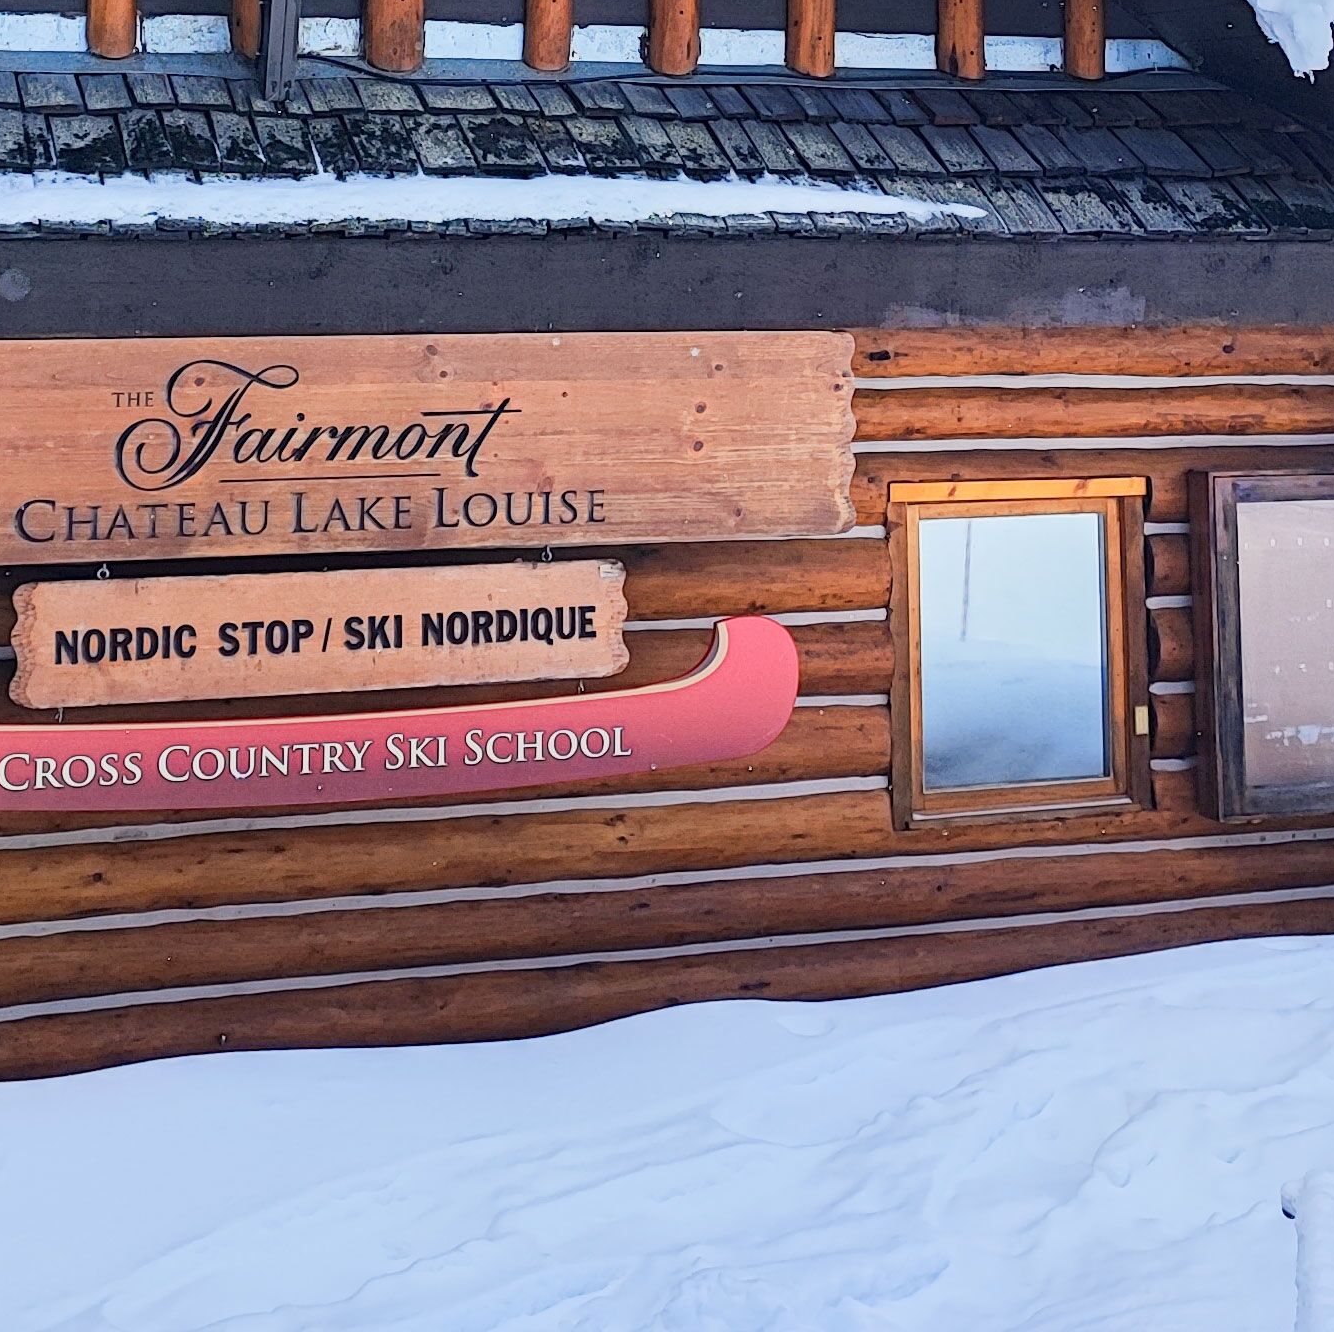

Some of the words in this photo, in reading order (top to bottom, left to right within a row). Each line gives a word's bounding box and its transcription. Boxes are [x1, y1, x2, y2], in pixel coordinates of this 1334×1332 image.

[112, 391, 155, 409] THE
[115, 359, 523, 492] Fairmont
[14, 499, 271, 544] CHATEAU
[291, 491, 413, 534] LAKE
[432, 486, 607, 528] LOUISE
[54, 624, 197, 665] NORDIC
[218, 618, 312, 656] STOP
[343, 614, 404, 651] SKI
[421, 605, 597, 647] NORDIQUE
[157, 740, 373, 782] COUNTRY
[384, 733, 448, 770] SKI
[464, 726, 633, 766] SCHOOL
